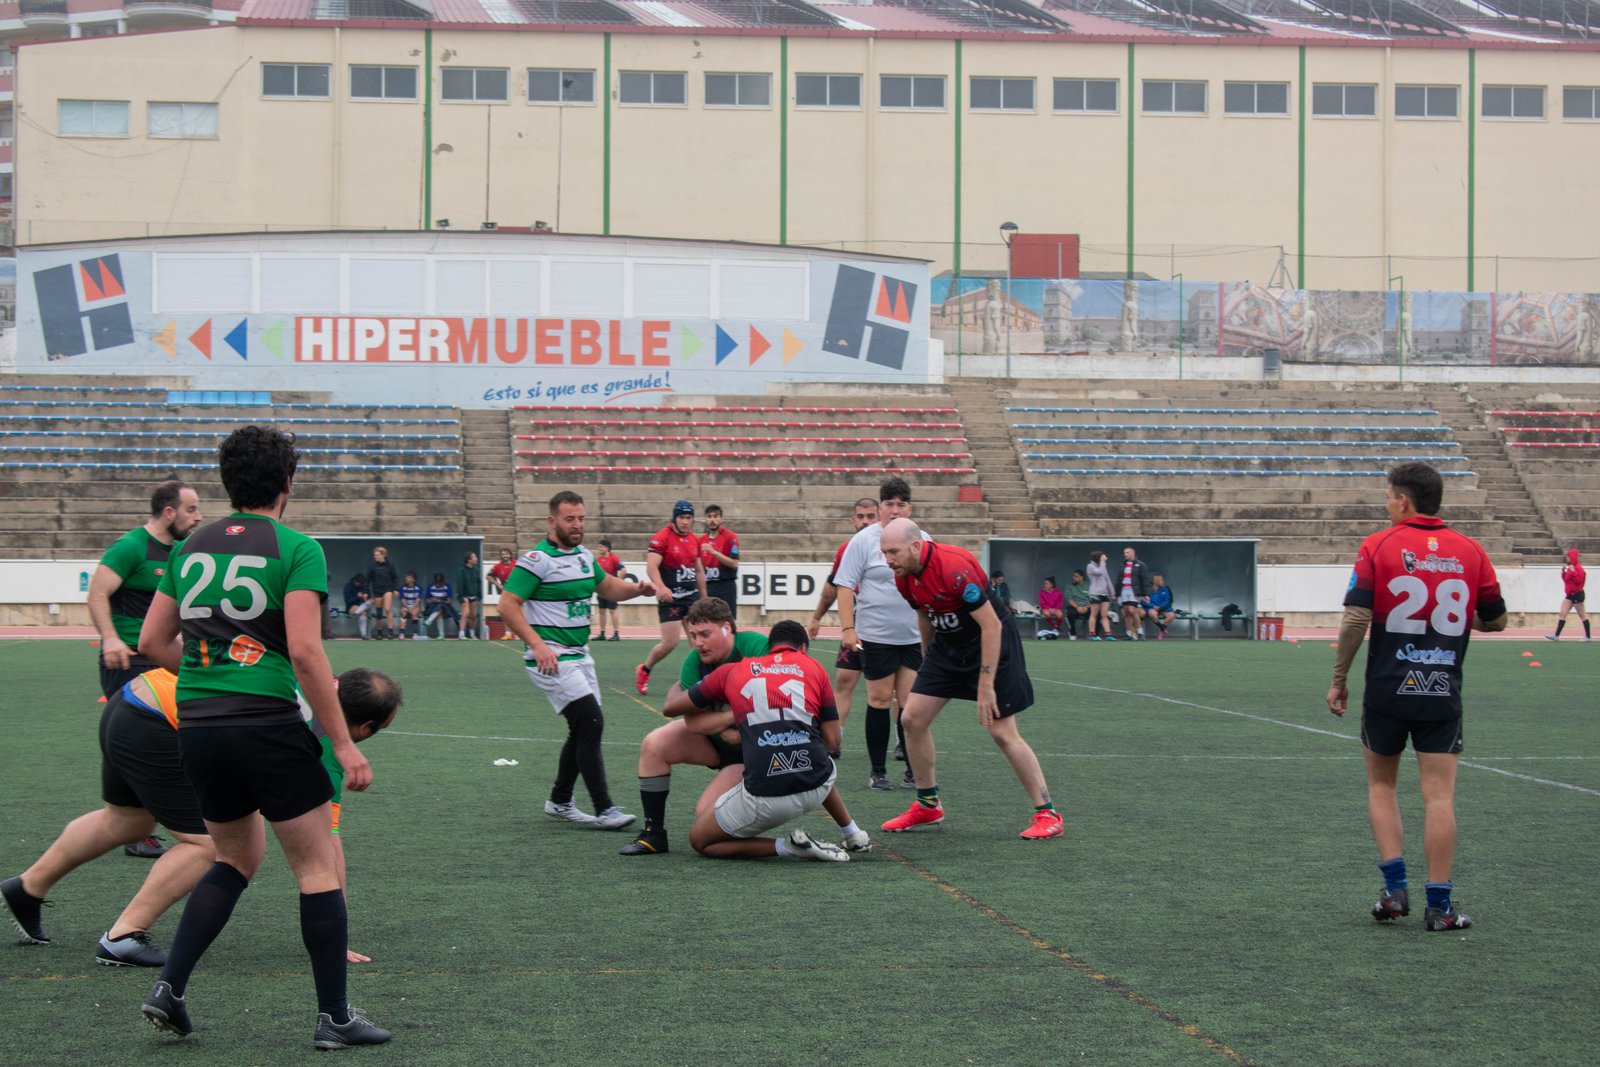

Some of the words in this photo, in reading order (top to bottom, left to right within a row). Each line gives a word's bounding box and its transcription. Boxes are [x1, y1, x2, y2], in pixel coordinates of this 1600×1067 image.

[300, 317, 671, 367] HIPERMUEBLE
[483, 385, 521, 401] Esto
[546, 385, 576, 401] que
[581, 382, 598, 394] es
[604, 371, 672, 396] grande!
[180, 552, 268, 621] 25
[1385, 575, 1470, 637] 28
[740, 677, 814, 726] 11
[1396, 670, 1451, 696] AVS
[767, 749, 813, 777] AVS
